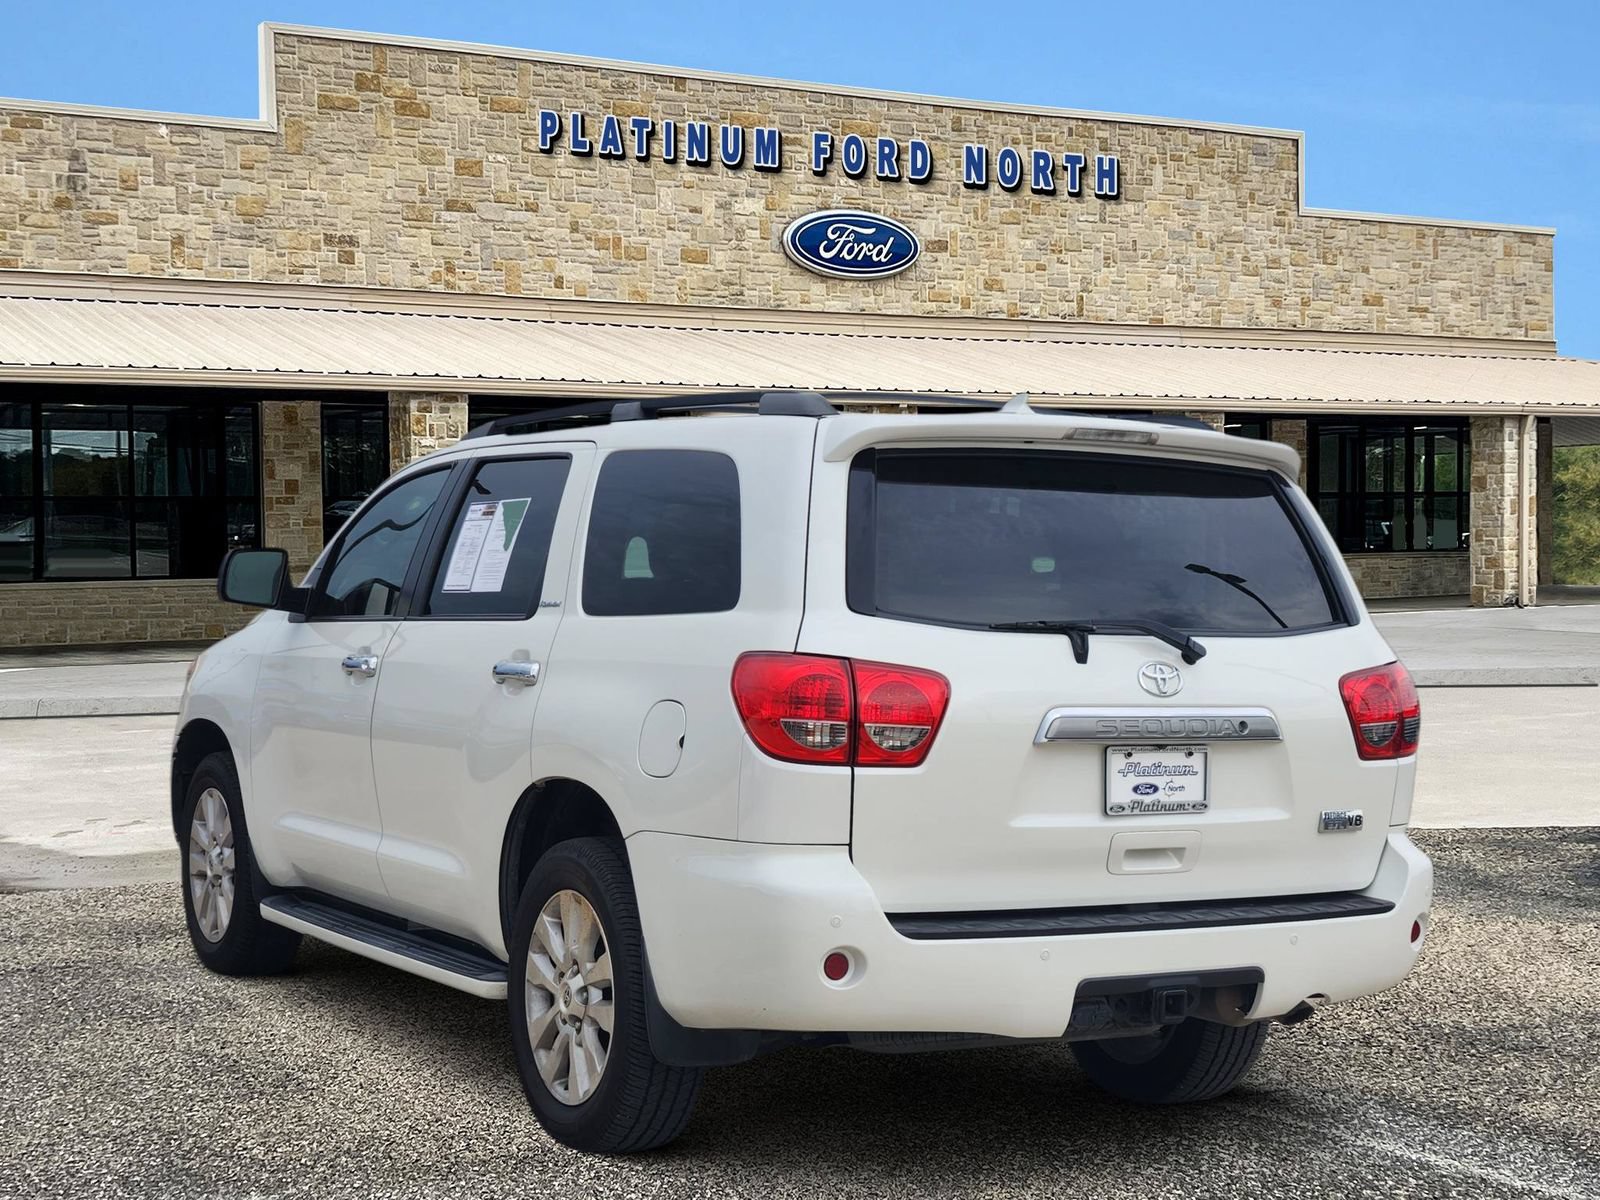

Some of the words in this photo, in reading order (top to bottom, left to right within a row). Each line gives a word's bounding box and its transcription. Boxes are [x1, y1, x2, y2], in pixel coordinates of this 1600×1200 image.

[538, 110, 782, 172] PLATINUM
[812, 131, 932, 185] FORD
[963, 143, 1120, 199] NORTH
[819, 223, 894, 263] Ford
[1096, 718, 1240, 736] SEQUOIA
[1118, 761, 1198, 777] Platinum
[1167, 784, 1185, 792] North
[1130, 798, 1188, 813] Platinum
